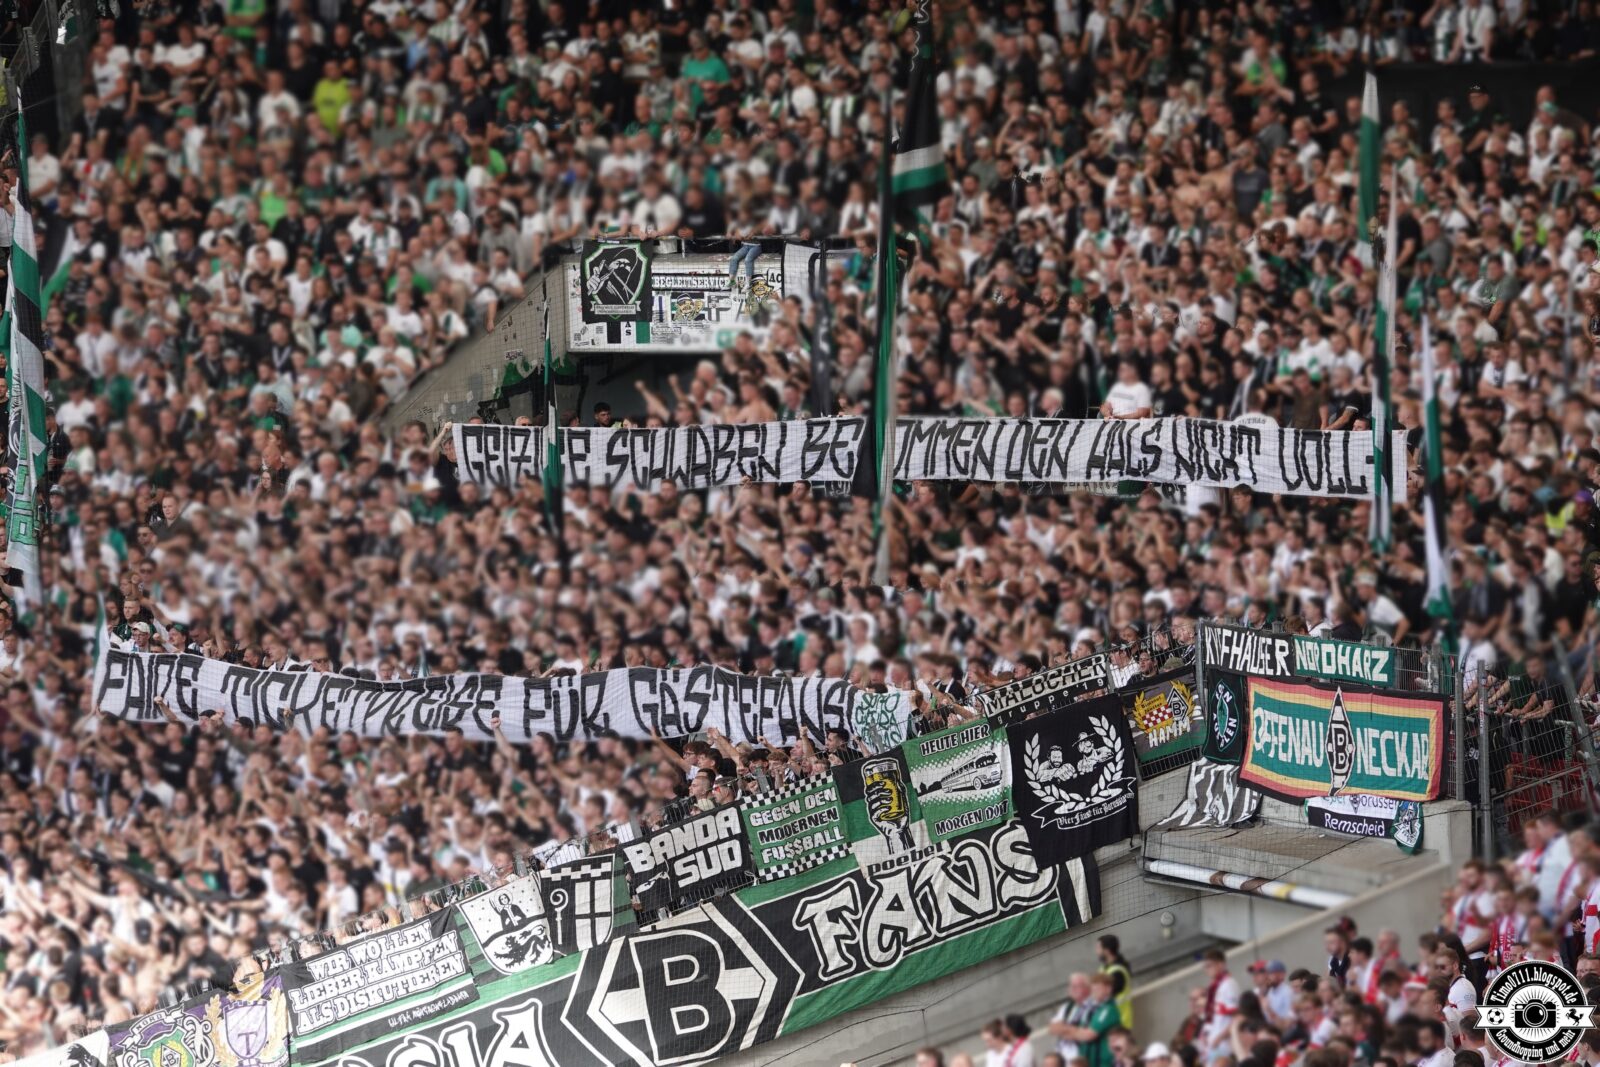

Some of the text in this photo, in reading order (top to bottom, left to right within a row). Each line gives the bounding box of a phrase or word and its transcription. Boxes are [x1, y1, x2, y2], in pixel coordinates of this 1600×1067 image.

[1004, 420, 1086, 480] DEN
[1085, 419, 1164, 480] HALS
[1171, 418, 1261, 485] NICHT
[1294, 638, 1390, 683] NORDHARZ
[523, 672, 611, 740] FÜR
[983, 653, 1107, 716] MALOCHER
[921, 724, 990, 757] HEUTE HIER
[1149, 716, 1190, 748] HAMM
[750, 786, 837, 827] GEGEN DEN
[757, 807, 839, 844] MODERNEN
[936, 809, 984, 836] MORGEN
[1324, 812, 1386, 837] Remscheid
[624, 807, 742, 874] BANDA
[791, 820, 1062, 982] FANS
[307, 921, 430, 980] WIR WOLLEN
[290, 967, 363, 1012] LIEBER
[297, 1001, 336, 1034] ALS
